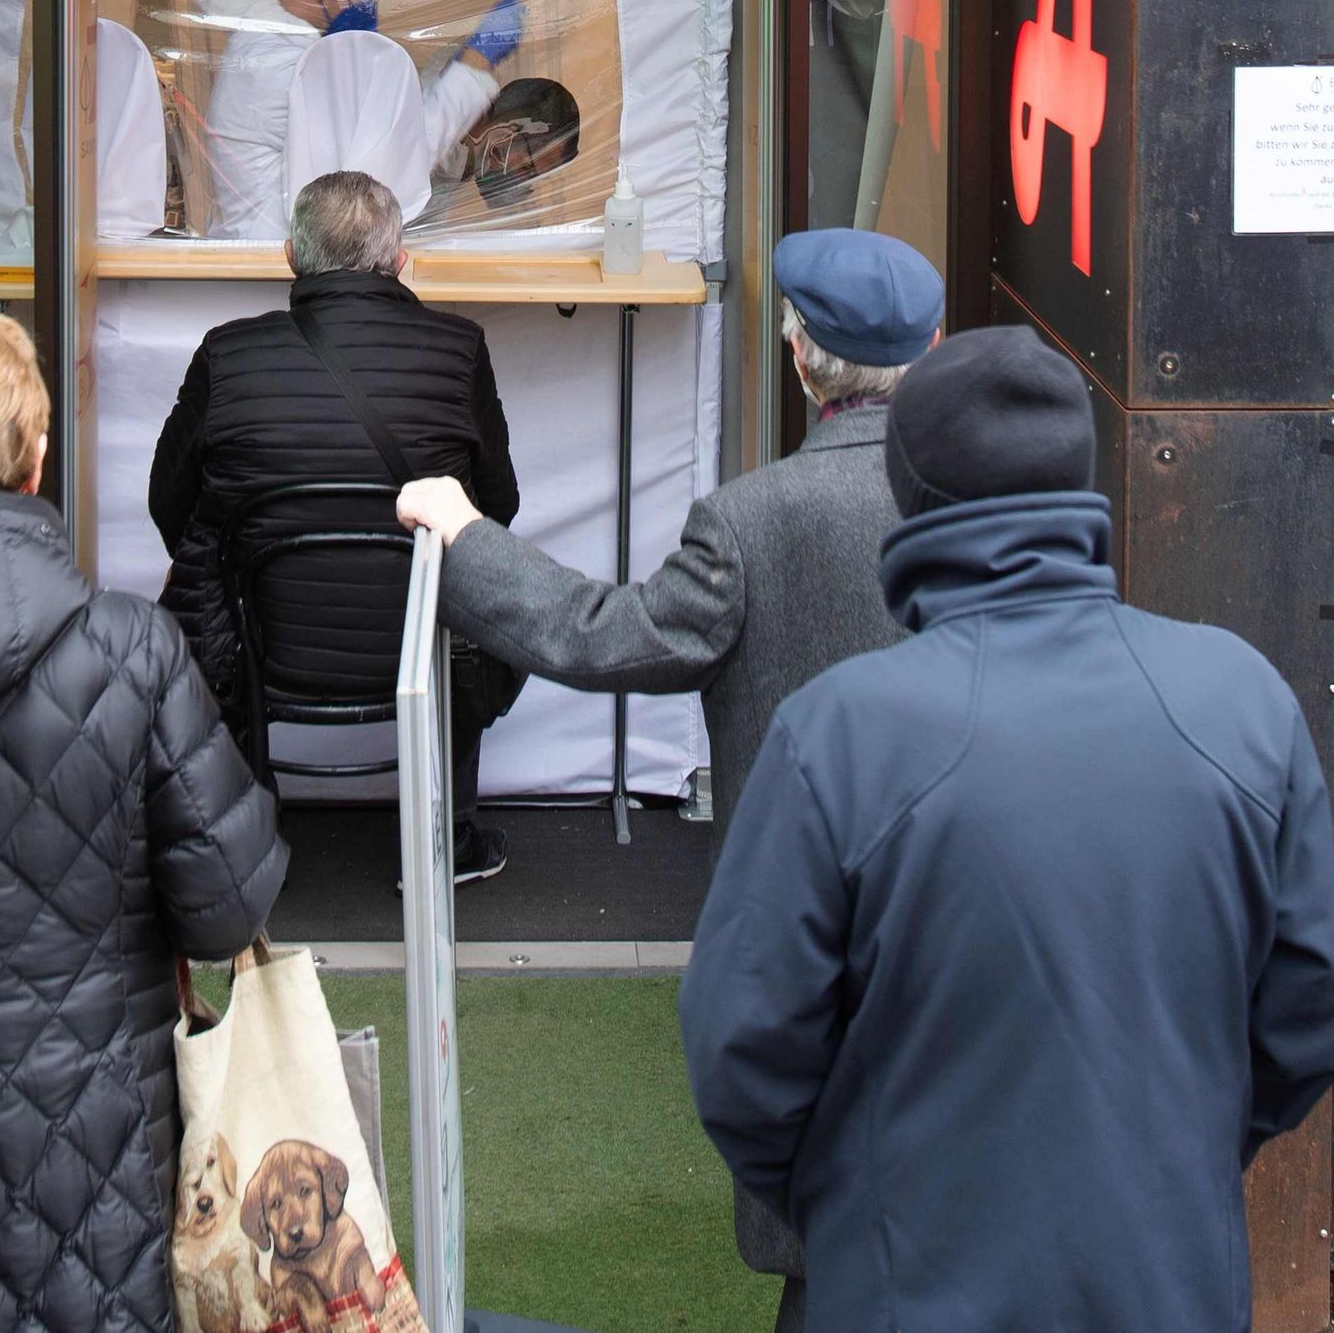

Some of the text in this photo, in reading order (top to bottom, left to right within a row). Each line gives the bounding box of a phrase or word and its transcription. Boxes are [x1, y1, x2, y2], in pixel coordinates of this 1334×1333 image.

[1296, 103, 1320, 112] Sehr
[1270, 124, 1300, 132] wenn
[1304, 122, 1319, 132] Sie
[1256, 140, 1289, 149] bitten
[1292, 141, 1308, 149] wir
[1312, 140, 1328, 149] Sie
[1275, 158, 1287, 167] zu
